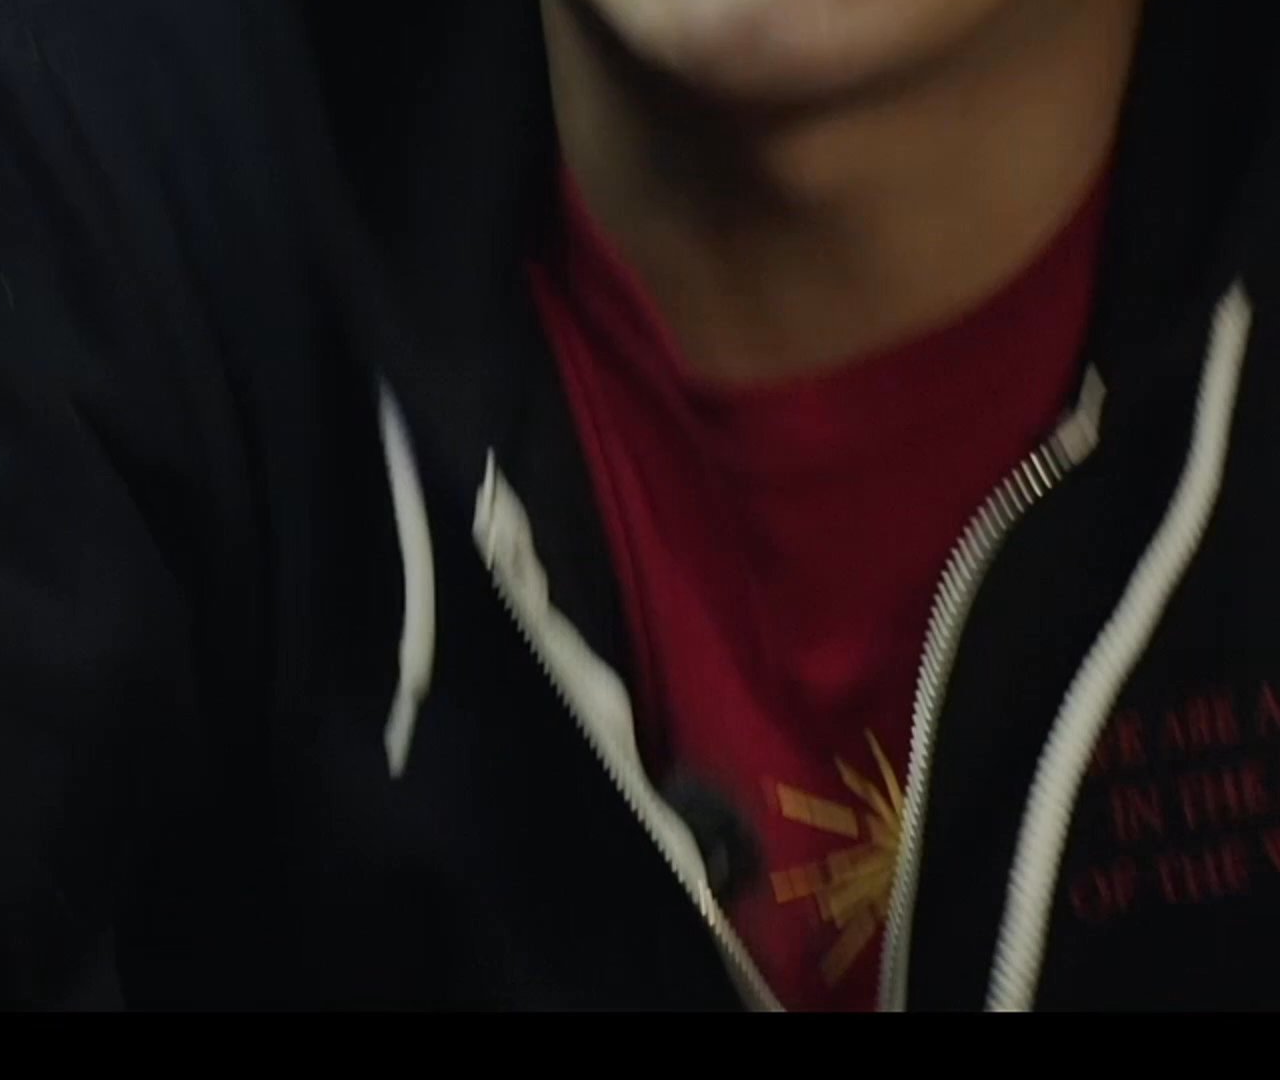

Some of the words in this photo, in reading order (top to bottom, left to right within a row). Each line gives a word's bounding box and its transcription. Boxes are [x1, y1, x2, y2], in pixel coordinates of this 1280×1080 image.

[1163, 688, 1240, 752] ARE
[1110, 782, 1167, 841] IN
[1175, 760, 1269, 831] THE
[1069, 858, 1138, 923] OF
[1155, 836, 1250, 904] THE
